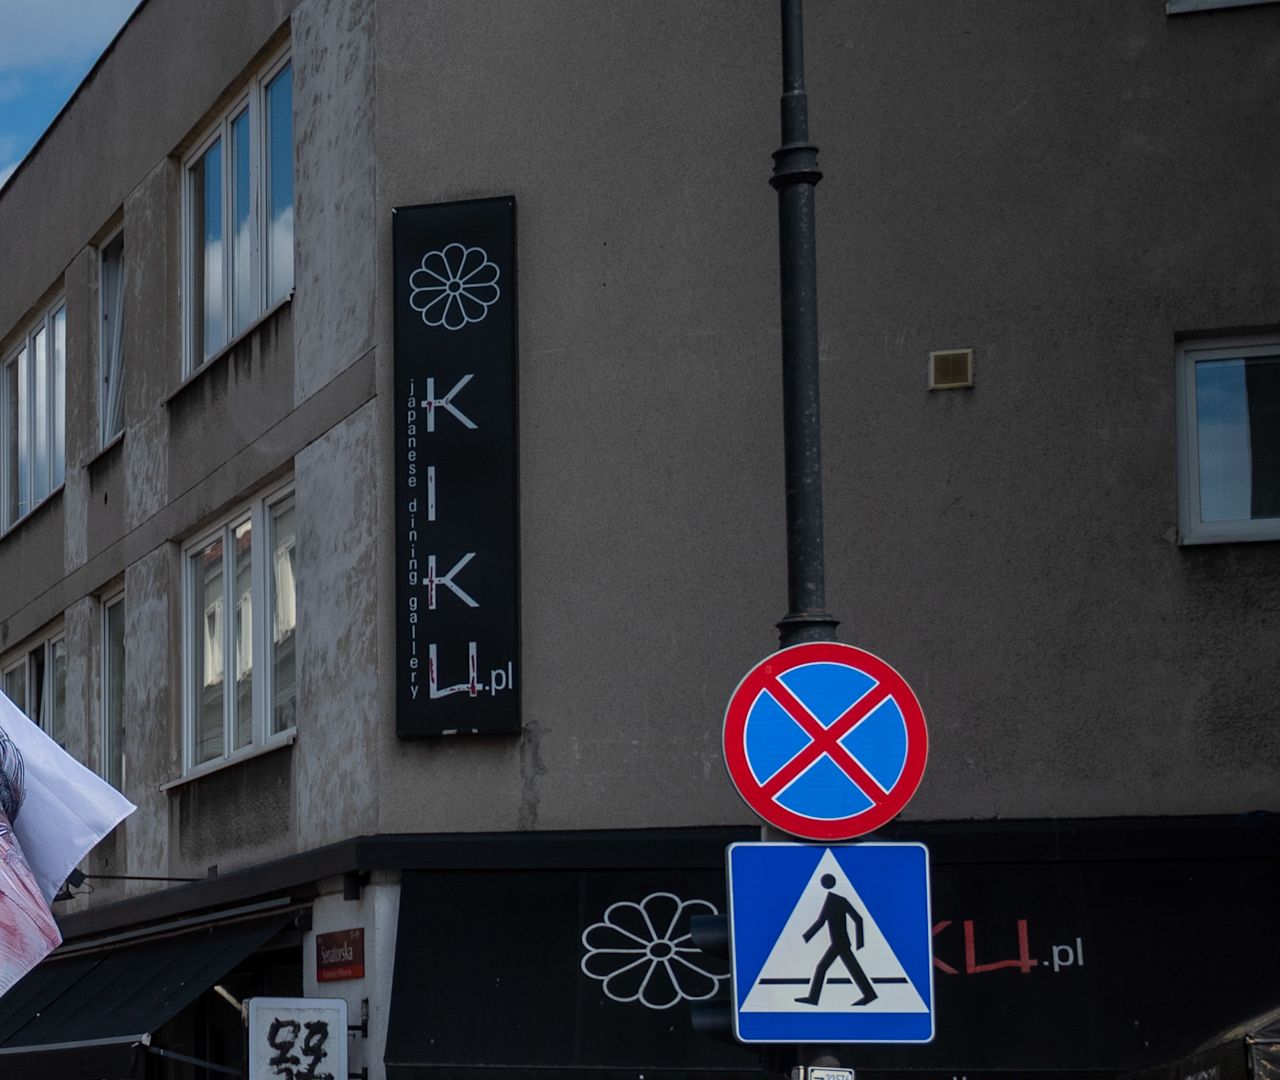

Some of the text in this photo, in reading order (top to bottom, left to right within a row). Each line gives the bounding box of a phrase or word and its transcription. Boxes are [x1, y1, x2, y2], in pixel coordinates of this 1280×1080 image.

[407, 378, 419, 700] japanese dining gallery
